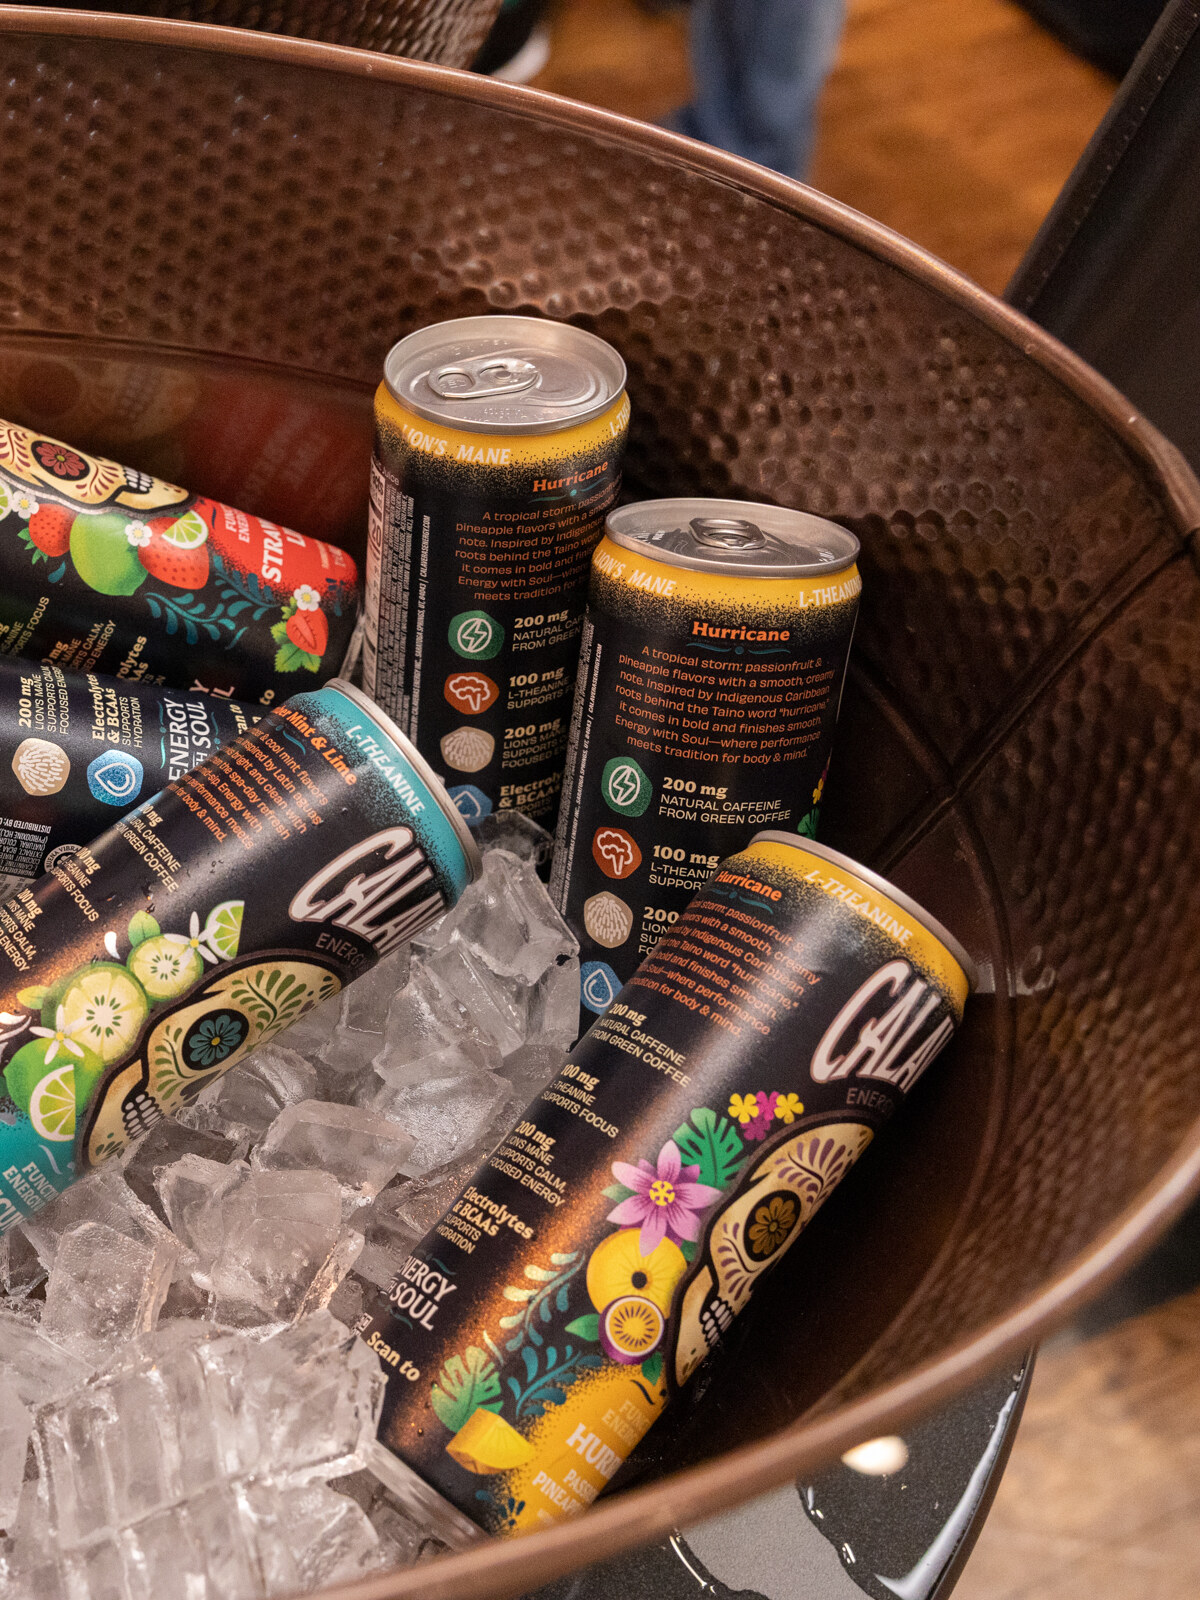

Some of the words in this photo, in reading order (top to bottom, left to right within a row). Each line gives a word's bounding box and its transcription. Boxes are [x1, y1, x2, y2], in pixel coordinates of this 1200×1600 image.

[456, 444, 510, 464] MANE
[533, 461, 608, 491] Hurricane
[455, 522, 513, 535] pineapple
[516, 522, 556, 534] flavors
[494, 510, 540, 522] tropical
[455, 550, 486, 561] roots
[489, 549, 530, 560] behind
[532, 546, 551, 558] the
[490, 537, 538, 549] Inspired
[457, 575, 498, 589] Energy
[472, 565, 512, 575] comes
[627, 569, 676, 596] MANE
[473, 592, 510, 601] meets
[26, 596, 49, 630] FOCUS
[514, 614, 544, 628] 200
[692, 621, 789, 641] Hurricane
[618, 654, 670, 677] pineapple
[672, 668, 715, 685] flavors
[718, 676, 746, 687] with
[651, 648, 698, 666] tropical
[20, 676, 35, 696] mg
[509, 672, 538, 687] 100
[86, 674, 110, 742] Electrolytes
[102, 688, 119, 727] BCAAs
[644, 693, 684, 711] behind
[687, 703, 708, 715] the
[747, 708, 777, 718] word
[697, 688, 714, 701] by
[716, 691, 782, 704] Indigenous
[17, 698, 32, 728] 200
[119, 696, 132, 747] SUPPORTS
[129, 696, 143, 748] HYDRATION
[184, 702, 211, 748] SOUL
[628, 705, 665, 722] comes
[667, 714, 679, 726] in
[164, 698, 189, 780] ENERGY
[504, 724, 536, 739] 200
[286, 711, 316, 737] Mint
[322, 748, 363, 785] Lime
[272, 768, 296, 793] Latin
[278, 751, 301, 773] mint
[297, 770, 331, 806] flavors
[346, 725, 424, 814] L-THEANINE
[214, 780, 248, 815] Energy
[225, 768, 262, 808] spa-day
[263, 783, 292, 813] clean
[660, 793, 719, 811] NATURAL
[662, 776, 696, 793] 200
[700, 785, 728, 800] mg
[658, 806, 697, 821] FROM
[700, 812, 745, 824] GREEN
[142, 829, 181, 872] CAFFEINE
[653, 845, 685, 861] 100
[143, 852, 182, 896] COFFEE
[715, 871, 782, 901] Hurricane
[70, 888, 99, 922] FOCUS
[291, 828, 451, 957] CALAV
[805, 870, 912, 944] L-THEANINE
[690, 928, 743, 957] Indigenous
[725, 908, 796, 952] passionfruit
[688, 960, 730, 988] finishes
[773, 951, 819, 984] creamy
[625, 1009, 646, 1033] mg
[809, 961, 956, 1094] CALAV
[609, 1035, 644, 1057] GREEN
[642, 1052, 693, 1089] COFFEE
[630, 1029, 686, 1066] CAFFEINE
[576, 1071, 599, 1097] mg
[578, 1108, 619, 1138] FOCUS
[524, 1143, 554, 1166] MANE
[529, 1130, 555, 1156] mg
[520, 1174, 565, 1206] ENERGY
[459, 1203, 499, 1236] BCAAs
[460, 1187, 533, 1239] Electrolytes
[389, 1282, 437, 1330] SOUL
[397, 1358, 423, 1383] to
